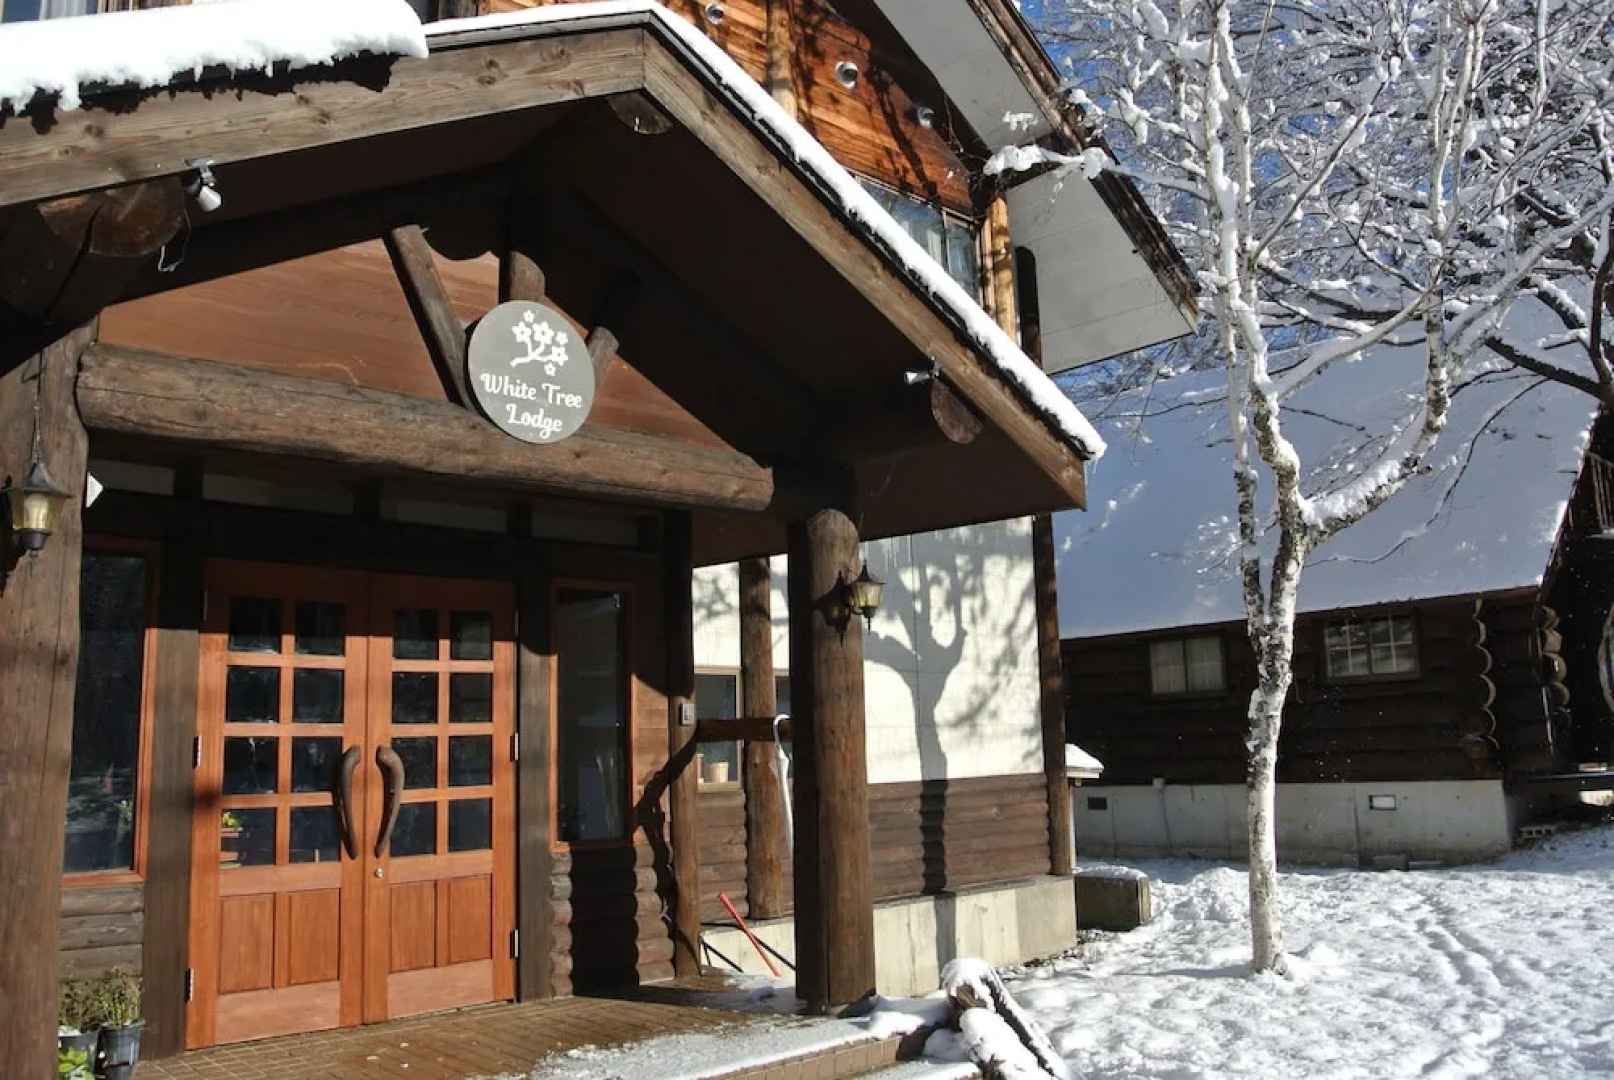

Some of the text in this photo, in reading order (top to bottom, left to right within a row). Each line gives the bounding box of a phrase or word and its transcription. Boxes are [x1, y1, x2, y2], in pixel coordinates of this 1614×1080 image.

[480, 372, 582, 408] White Tree
[505, 403, 563, 439] Lodge
